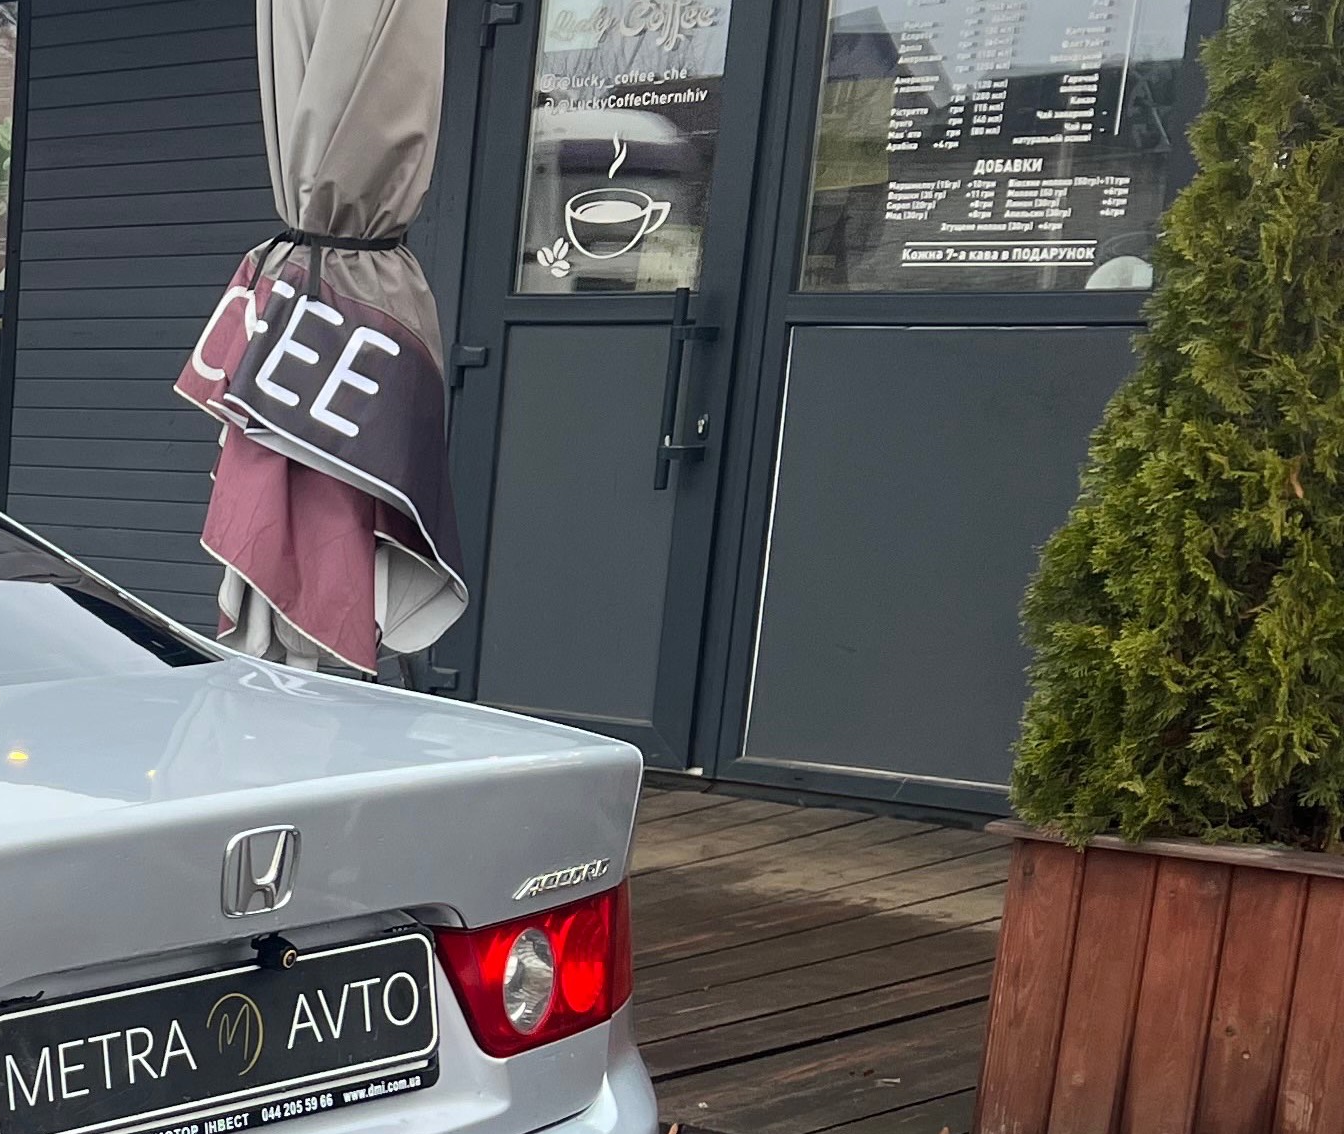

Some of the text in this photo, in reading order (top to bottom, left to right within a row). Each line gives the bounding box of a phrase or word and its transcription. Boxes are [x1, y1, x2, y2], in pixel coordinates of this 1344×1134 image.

[972, 157, 1044, 176] ДОБАВКИ
[902, 248, 944, 261] Кожна
[968, 250, 999, 261] кава
[1001, 250, 1010, 261] в
[1011, 247, 1096, 262] ПОДАРУНОК
[4, 1019, 198, 1111] METRA
[287, 971, 419, 1050] AVTO
[261, 1107, 282, 1122] 044
[283, 1099, 303, 1118] 205
[305, 1096, 318, 1112] 59
[319, 1093, 333, 1108] 66
[343, 1074, 421, 1103] www.dmi.com.ua
